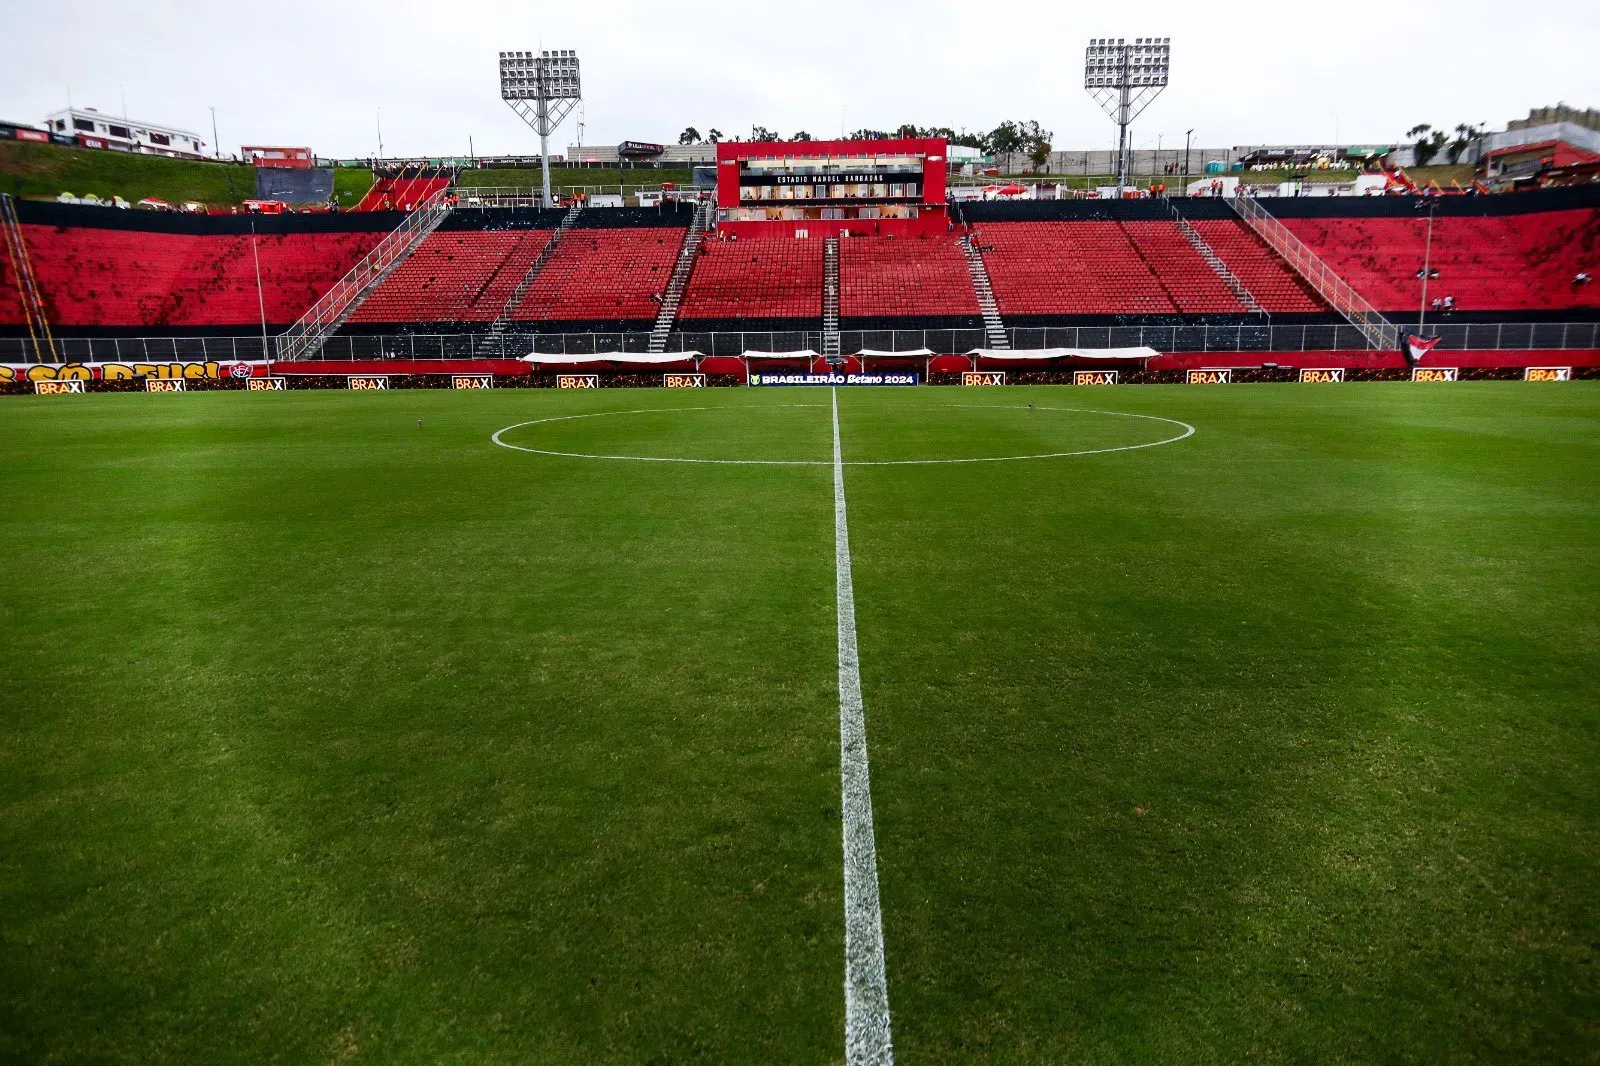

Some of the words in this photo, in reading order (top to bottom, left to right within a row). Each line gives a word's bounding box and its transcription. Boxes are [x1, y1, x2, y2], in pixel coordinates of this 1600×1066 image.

[812, 175, 840, 183] MANOEL
[845, 174, 883, 182] BARRADAS
[762, 371, 845, 384] BRASILEIRÃO
[847, 373, 882, 384] Betano
[885, 375, 914, 383] 2024
[965, 374, 1002, 385] BRAX
[1077, 373, 1114, 384] BRAX
[1190, 371, 1227, 383] BRAX
[1303, 370, 1340, 382] BRAX
[1415, 369, 1454, 381] BRAX
[1528, 369, 1567, 381] BRAX
[149, 380, 182, 392] BRAX
[249, 379, 283, 391] BRAX
[351, 378, 385, 389] BRAX
[455, 377, 489, 389] BRAX
[560, 377, 595, 388] BRAX
[667, 376, 702, 387] BRAX
[39, 382, 81, 394] BRAX
